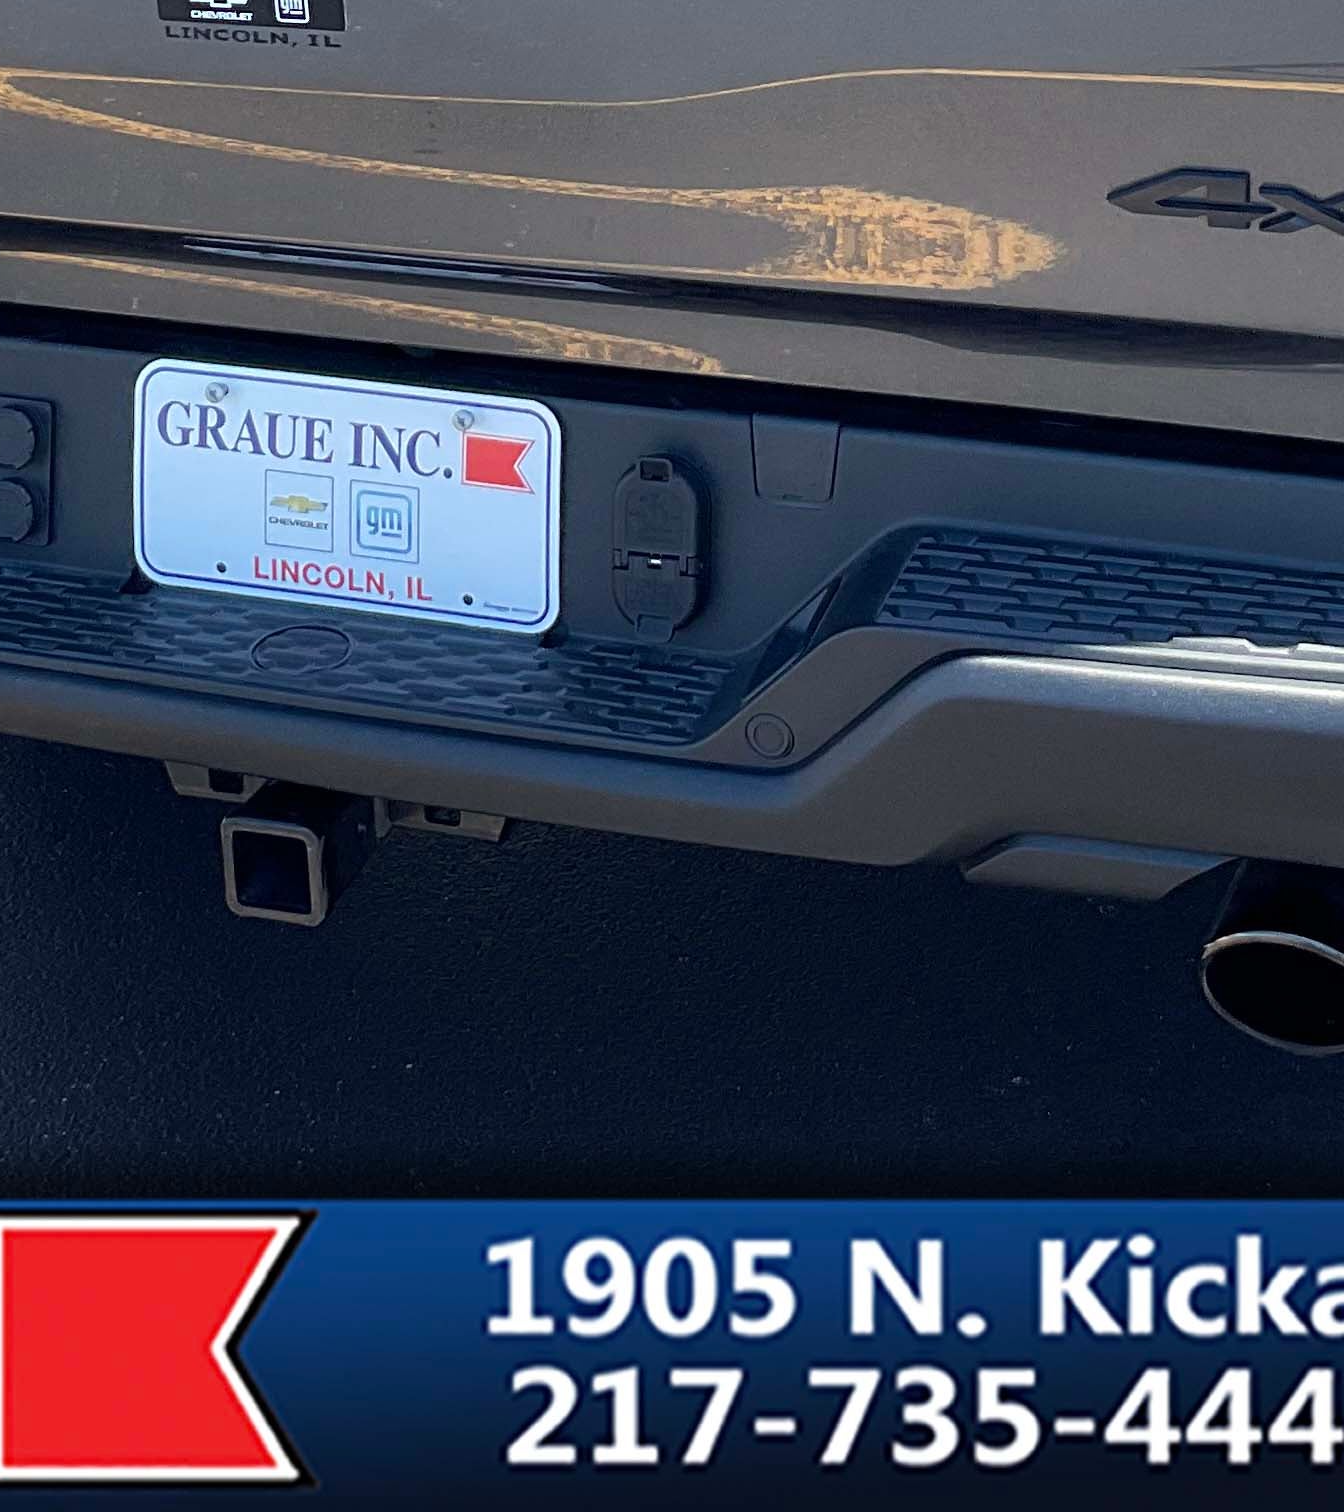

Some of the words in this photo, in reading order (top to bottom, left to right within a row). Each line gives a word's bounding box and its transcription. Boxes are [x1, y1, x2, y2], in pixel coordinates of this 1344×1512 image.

[190, 8, 254, 22] CHEVROLET
[165, 24, 298, 49] LINCOLN,
[307, 34, 342, 48] IL
[157, 400, 334, 464] GRAUE
[348, 421, 453, 479] INC.
[268, 515, 329, 531] CHEVROLET
[366, 506, 403, 538] gm
[253, 555, 394, 600] LINCOLN,
[406, 578, 432, 601] IL
